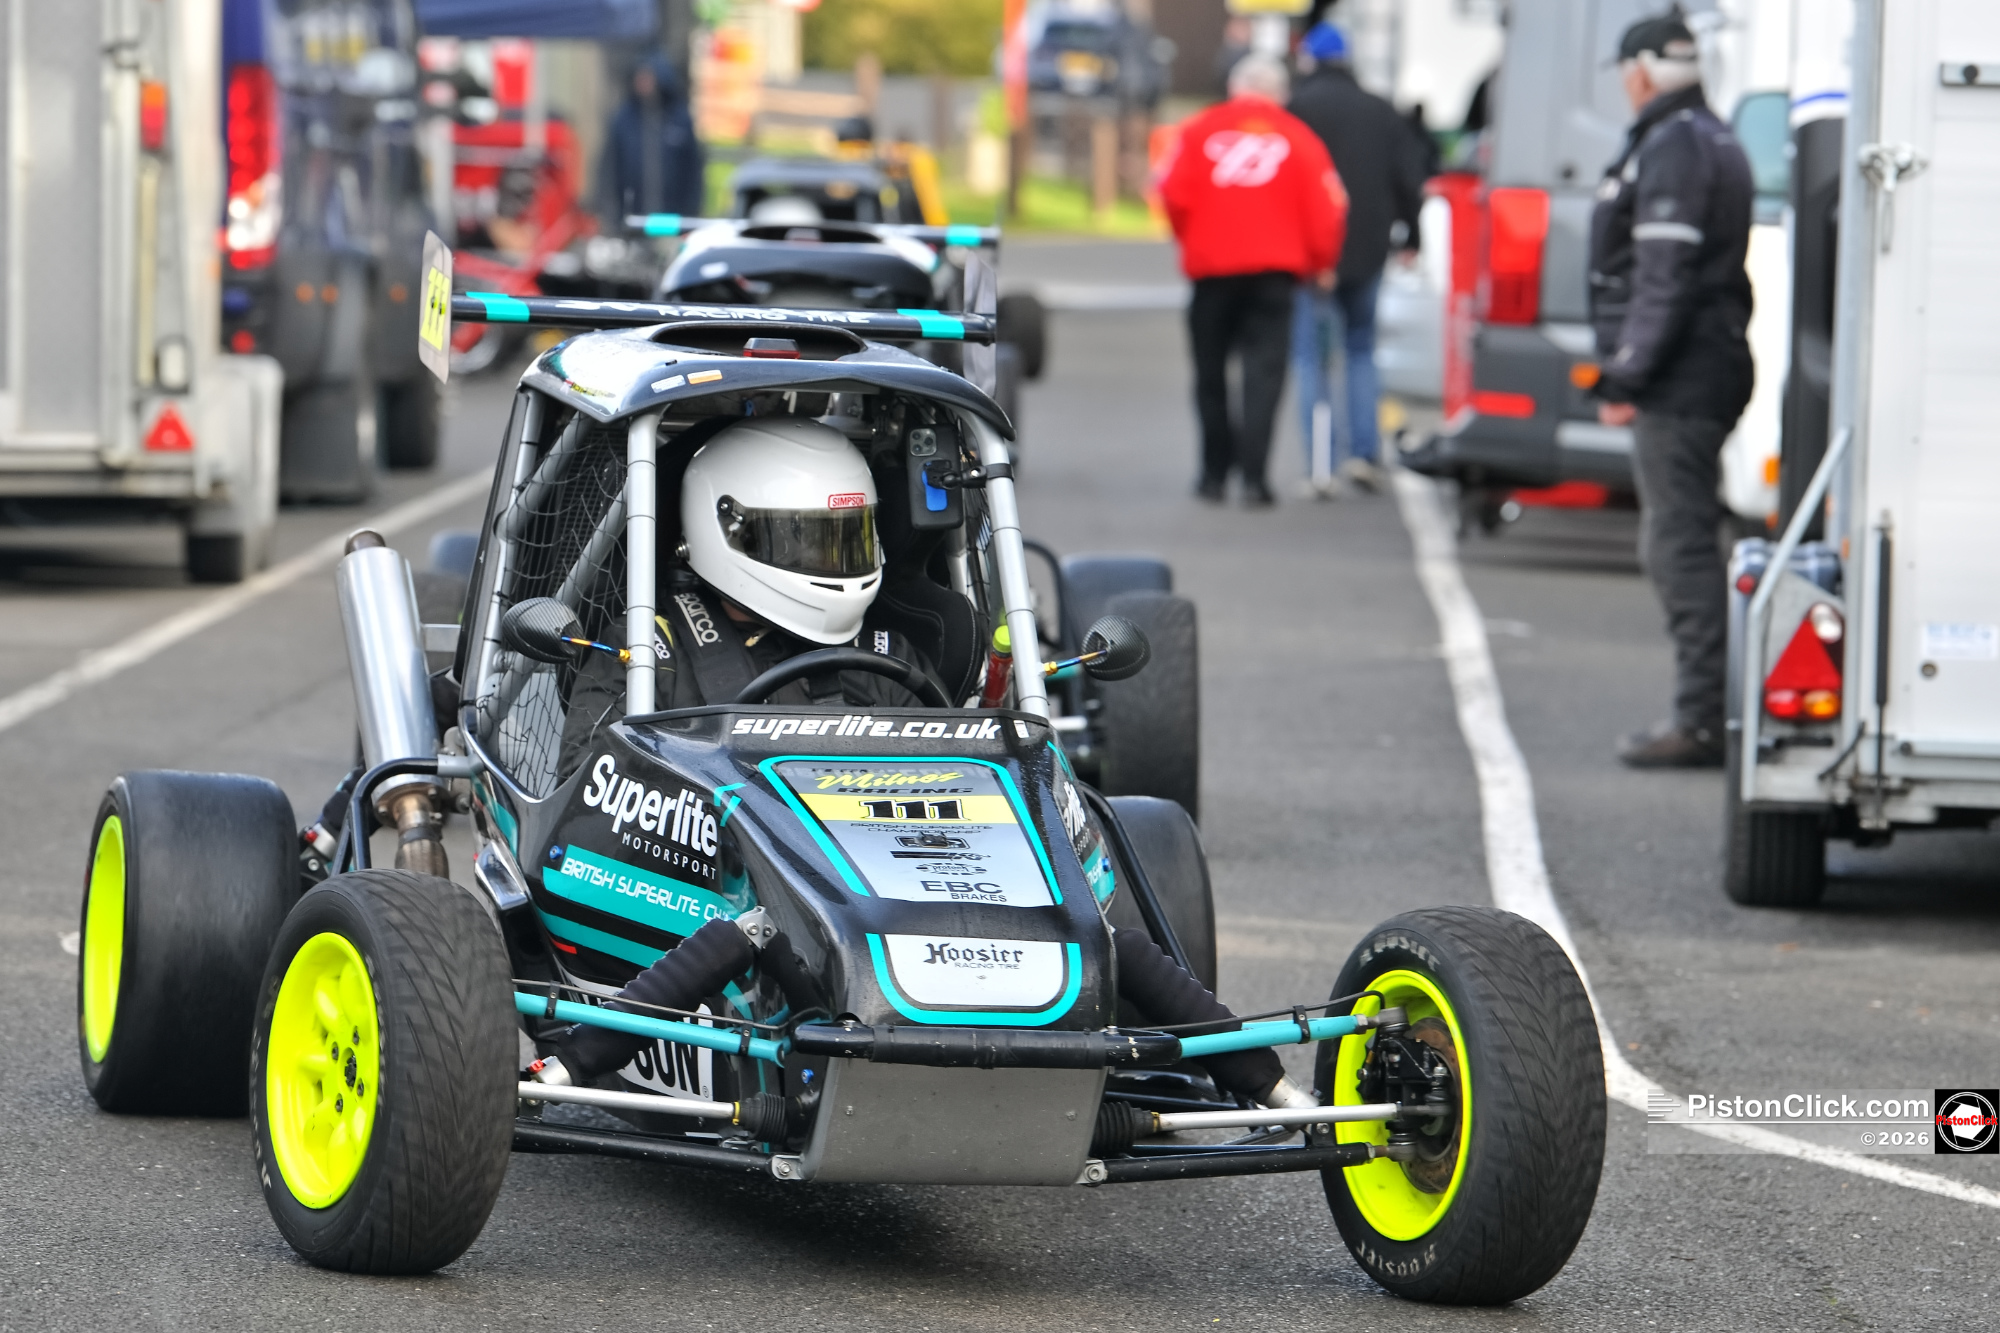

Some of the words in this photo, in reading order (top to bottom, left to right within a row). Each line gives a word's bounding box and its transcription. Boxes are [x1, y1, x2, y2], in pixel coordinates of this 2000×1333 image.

[832, 496, 864, 507] SIMPSON
[731, 715, 1001, 740] superlite.co.uk
[583, 754, 718, 857] Superlite
[859, 798, 970, 820] 111
[622, 832, 717, 880] MOTORSPORT
[560, 857, 616, 889] BRITISH
[615, 876, 700, 917] SUPERLITE
[920, 880, 1003, 894] EBC
[950, 893, 1008, 903] BRAKES
[923, 942, 1024, 964] Hoosier
